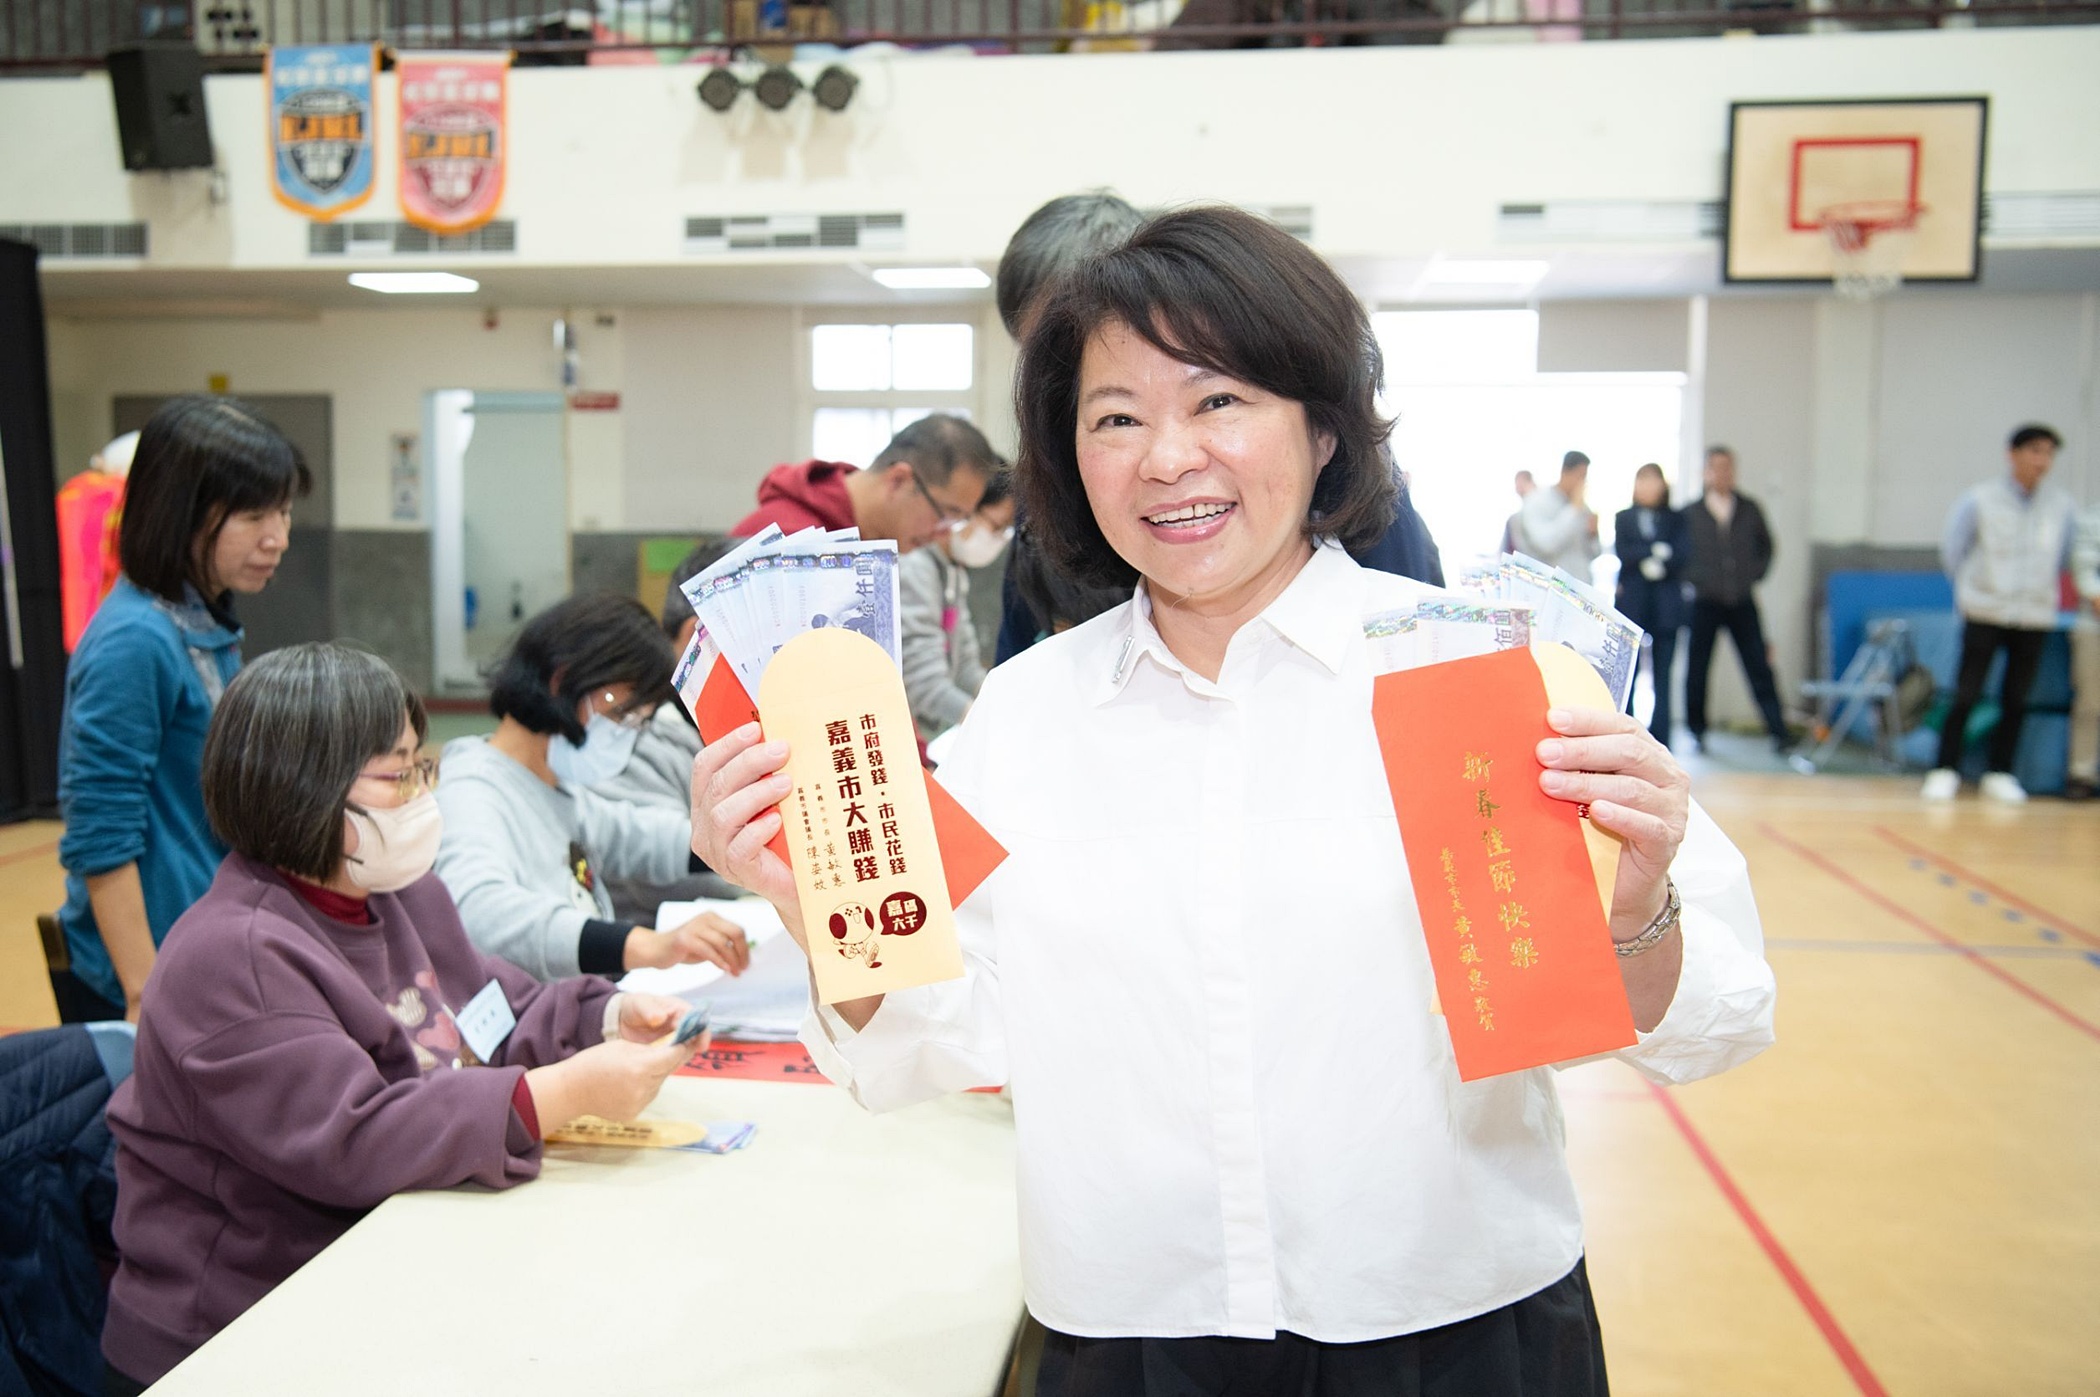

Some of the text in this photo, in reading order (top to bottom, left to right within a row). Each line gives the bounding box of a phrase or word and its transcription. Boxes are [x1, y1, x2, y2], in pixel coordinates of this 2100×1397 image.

[1494, 610, 1513, 652] 佰圓
[825, 719, 880, 883] 嘉義市大賺錢
[1461, 751, 1540, 970] 新春佳節快樂
[892, 913, 919, 932] 六千
